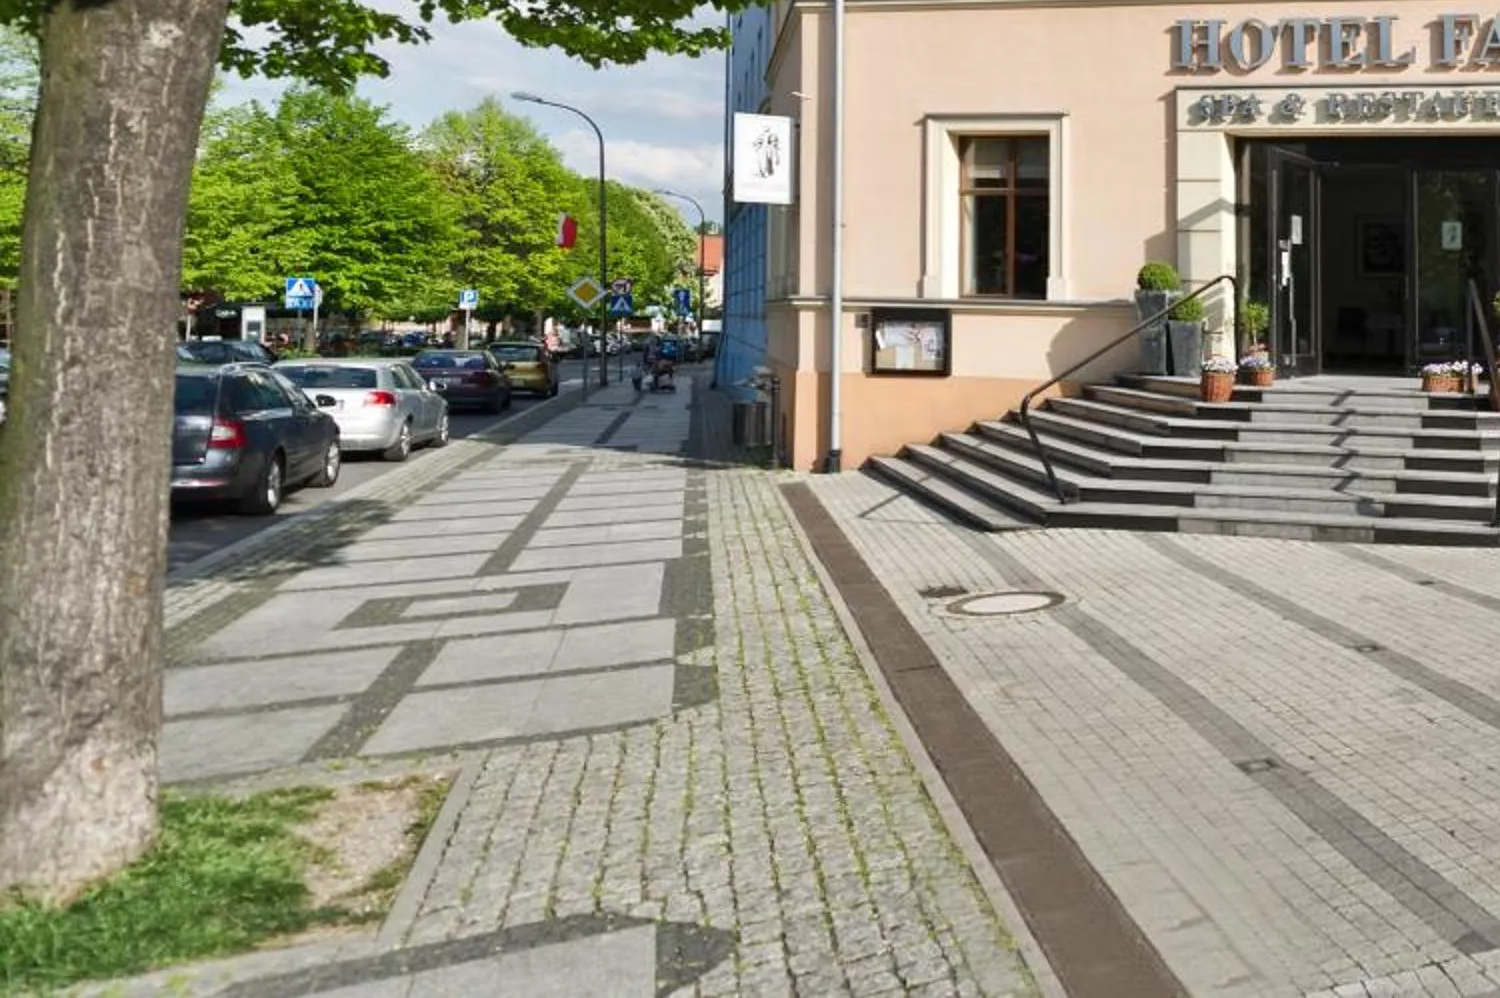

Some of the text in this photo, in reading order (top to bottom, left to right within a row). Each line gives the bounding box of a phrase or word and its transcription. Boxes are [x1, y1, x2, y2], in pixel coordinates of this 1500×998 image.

[1173, 16, 1416, 68] HOTEL
[1197, 93, 1264, 117] SPA
[1281, 92, 1308, 116] &
